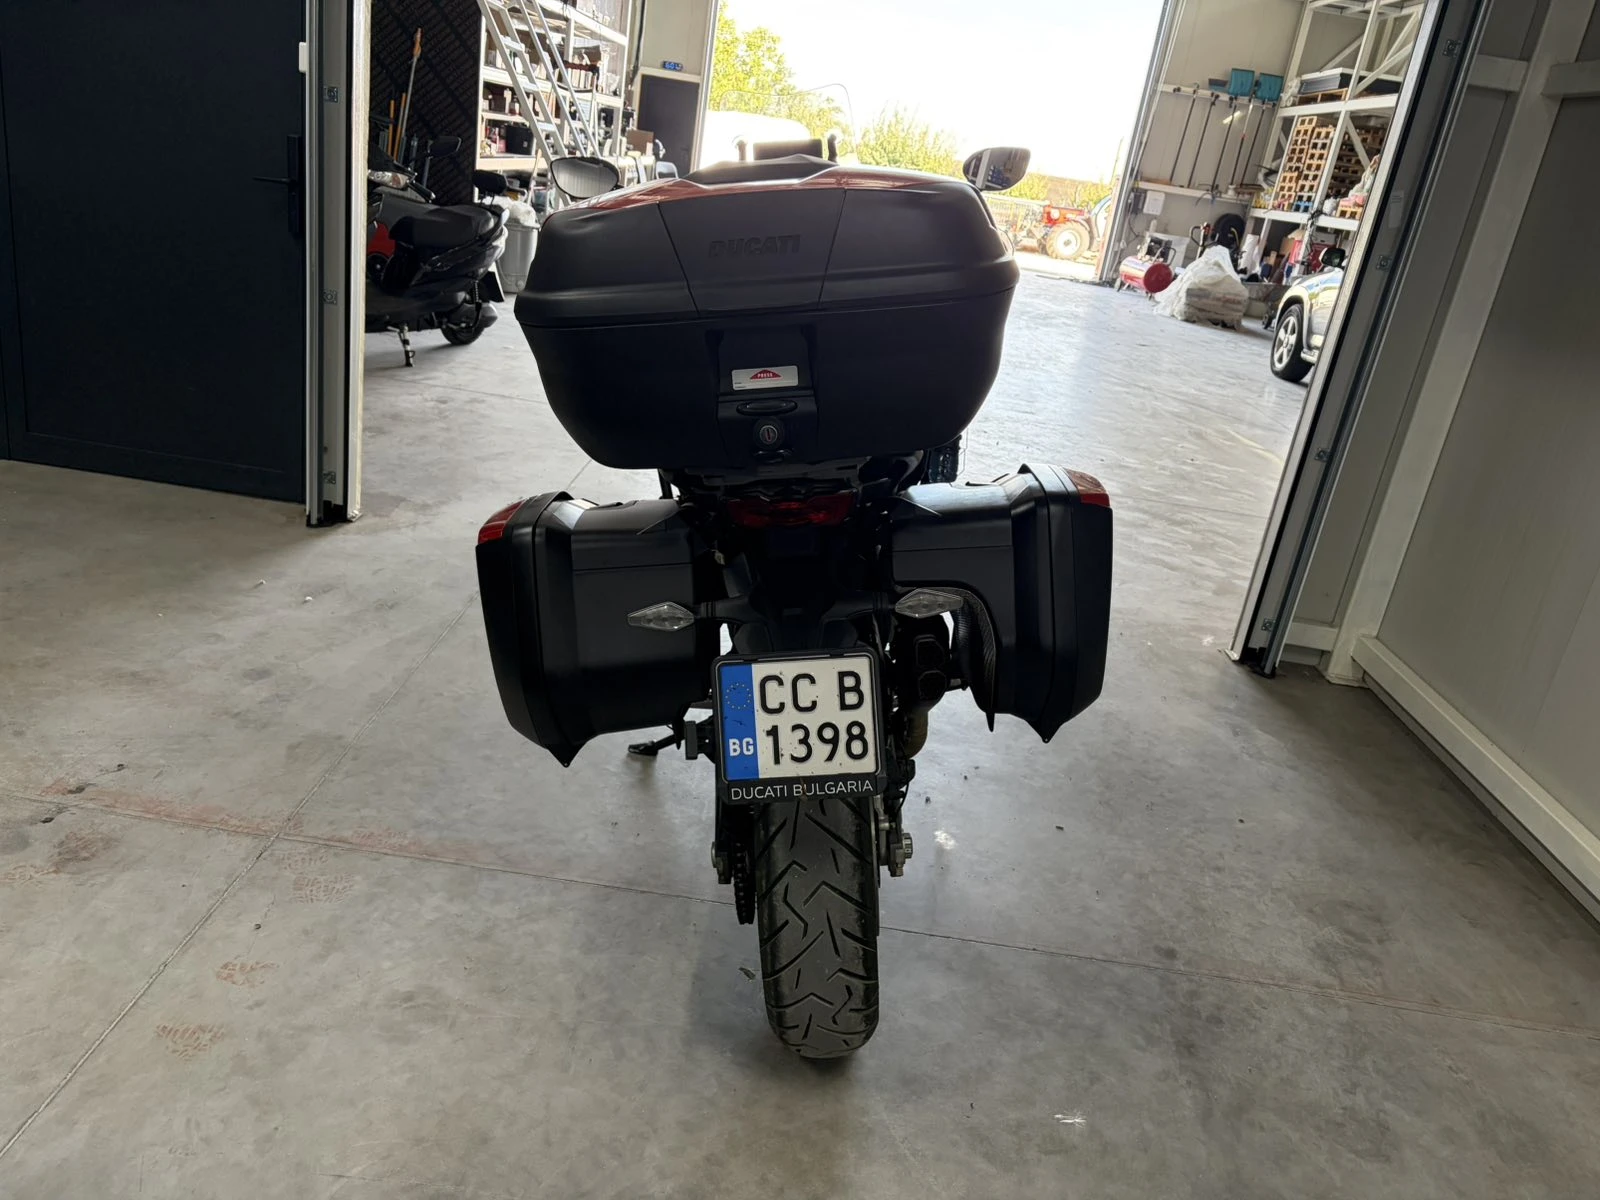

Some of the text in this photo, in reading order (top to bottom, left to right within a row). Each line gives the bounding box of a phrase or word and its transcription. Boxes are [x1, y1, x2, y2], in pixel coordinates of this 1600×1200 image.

[709, 234, 801, 258] DUCATI
[759, 670, 865, 715] CC B
[728, 737, 755, 757] BG
[765, 720, 869, 766] 1398
[731, 779, 874, 801] DUCATI BULGARIA
